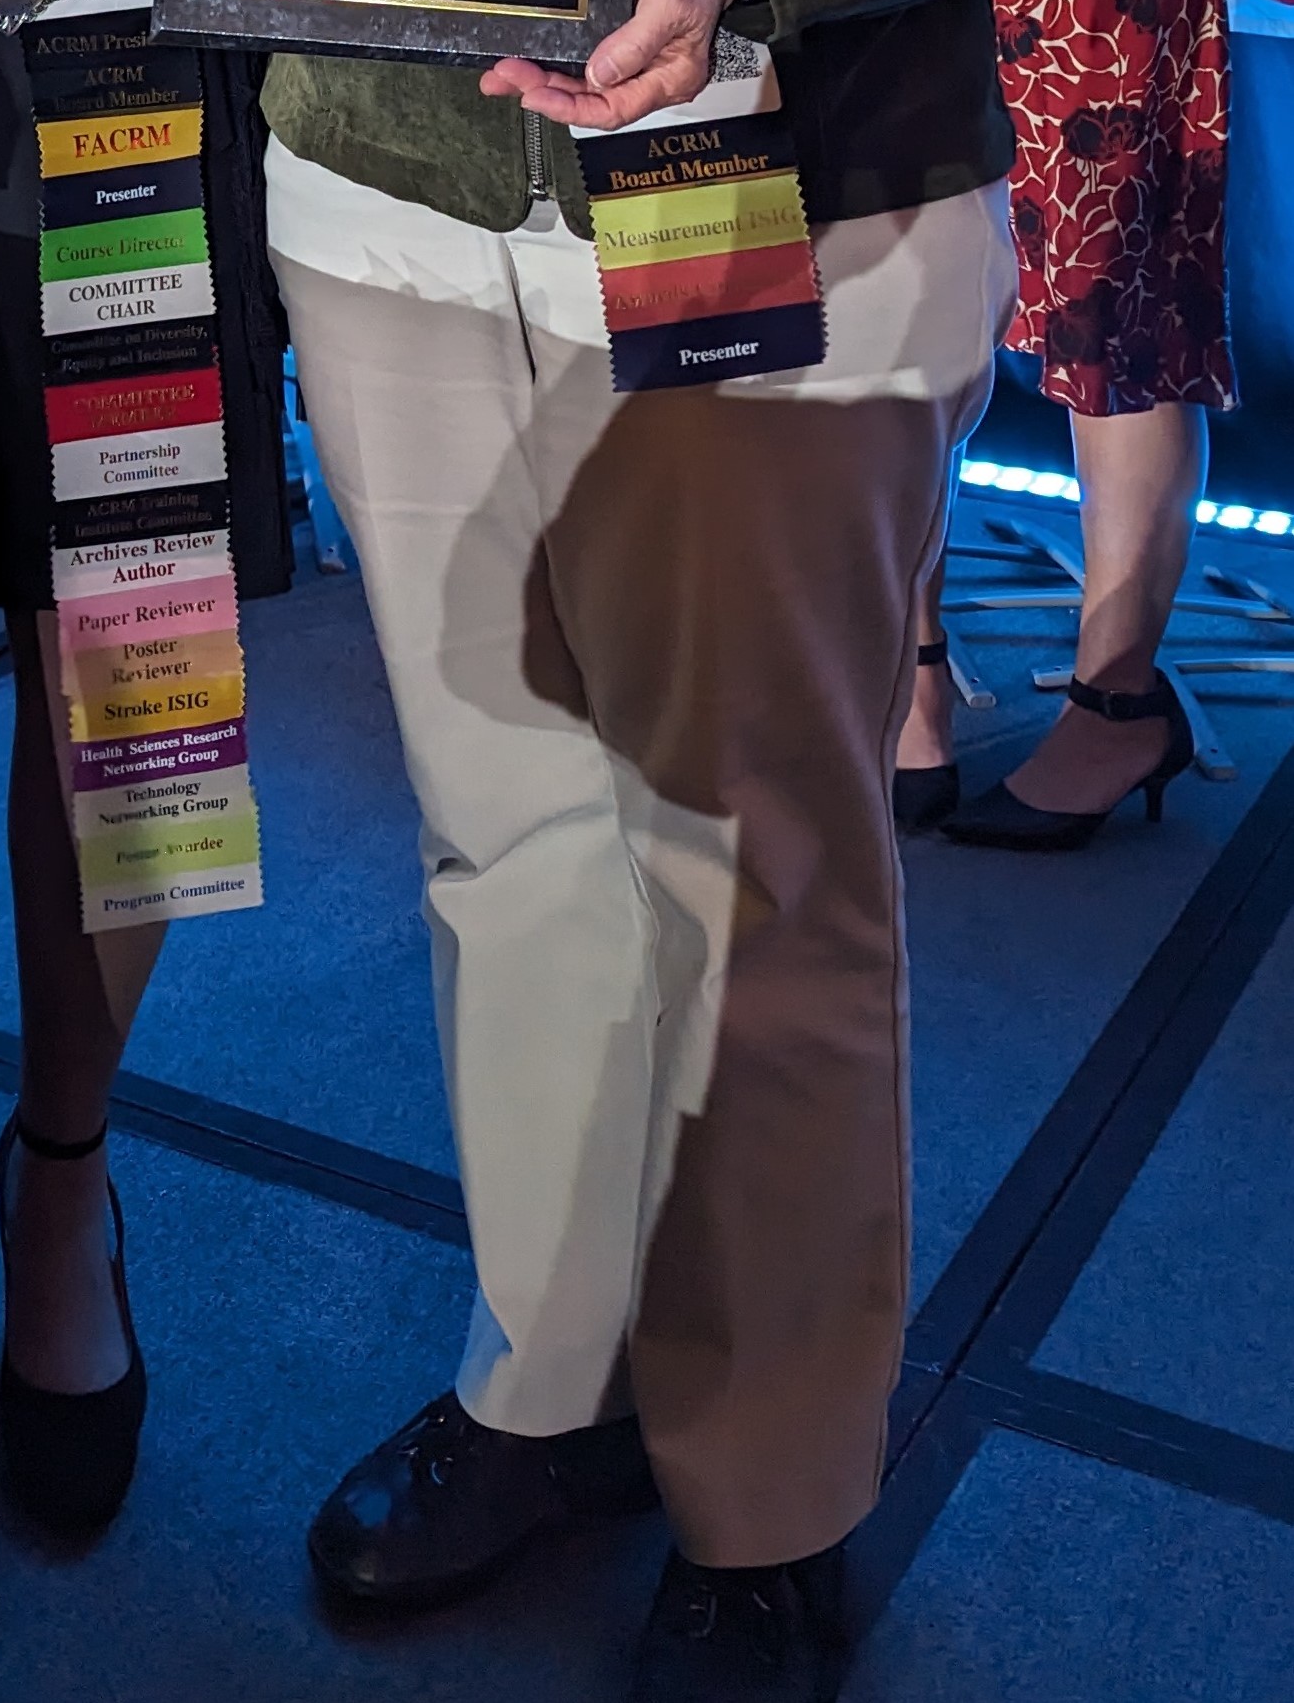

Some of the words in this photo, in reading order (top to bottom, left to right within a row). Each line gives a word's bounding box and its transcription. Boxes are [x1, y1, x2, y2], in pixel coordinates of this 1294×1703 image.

[36, 35, 98, 54] ACRM
[104, 31, 147, 50] Presi
[85, 65, 146, 86] ACRM
[109, 88, 180, 107] Member
[73, 123, 172, 158] FACRM
[648, 130, 722, 158] ACRM
[610, 163, 676, 190] Board
[682, 154, 769, 179] Member
[96, 184, 157, 205] Presenter
[605, 216, 742, 250] Measurement
[748, 206, 798, 231] ISIG
[56, 240, 114, 263] Course
[120, 236, 185, 256] Director
[69, 273, 183, 302] COMMITTEE
[97, 299, 156, 321] CHAIR
[145, 324, 208, 341] Diversity,
[679, 341, 760, 366] Presenter
[99, 443, 181, 466] Partnership
[103, 464, 179, 484] Committee
[70, 540, 148, 566] Archives
[153, 531, 216, 555] Review
[112, 561, 176, 584] Author
[78, 612, 130, 633] Paper
[136, 598, 216, 623] Reviewer
[123, 640, 178, 660] Poster
[112, 660, 192, 685] Reviewer
[104, 701, 163, 721] Stroke
[167, 692, 209, 711] ISIG
[81, 747, 123, 764] Health
[130, 737, 180, 756] Sciences
[184, 725, 238, 747] Research
[104, 757, 176, 778] Networking
[178, 748, 220, 766] Group
[125, 781, 202, 804] Technology
[183, 796, 229, 814] Group
[103, 891, 165, 912] Program
[170, 878, 245, 901] Committee
